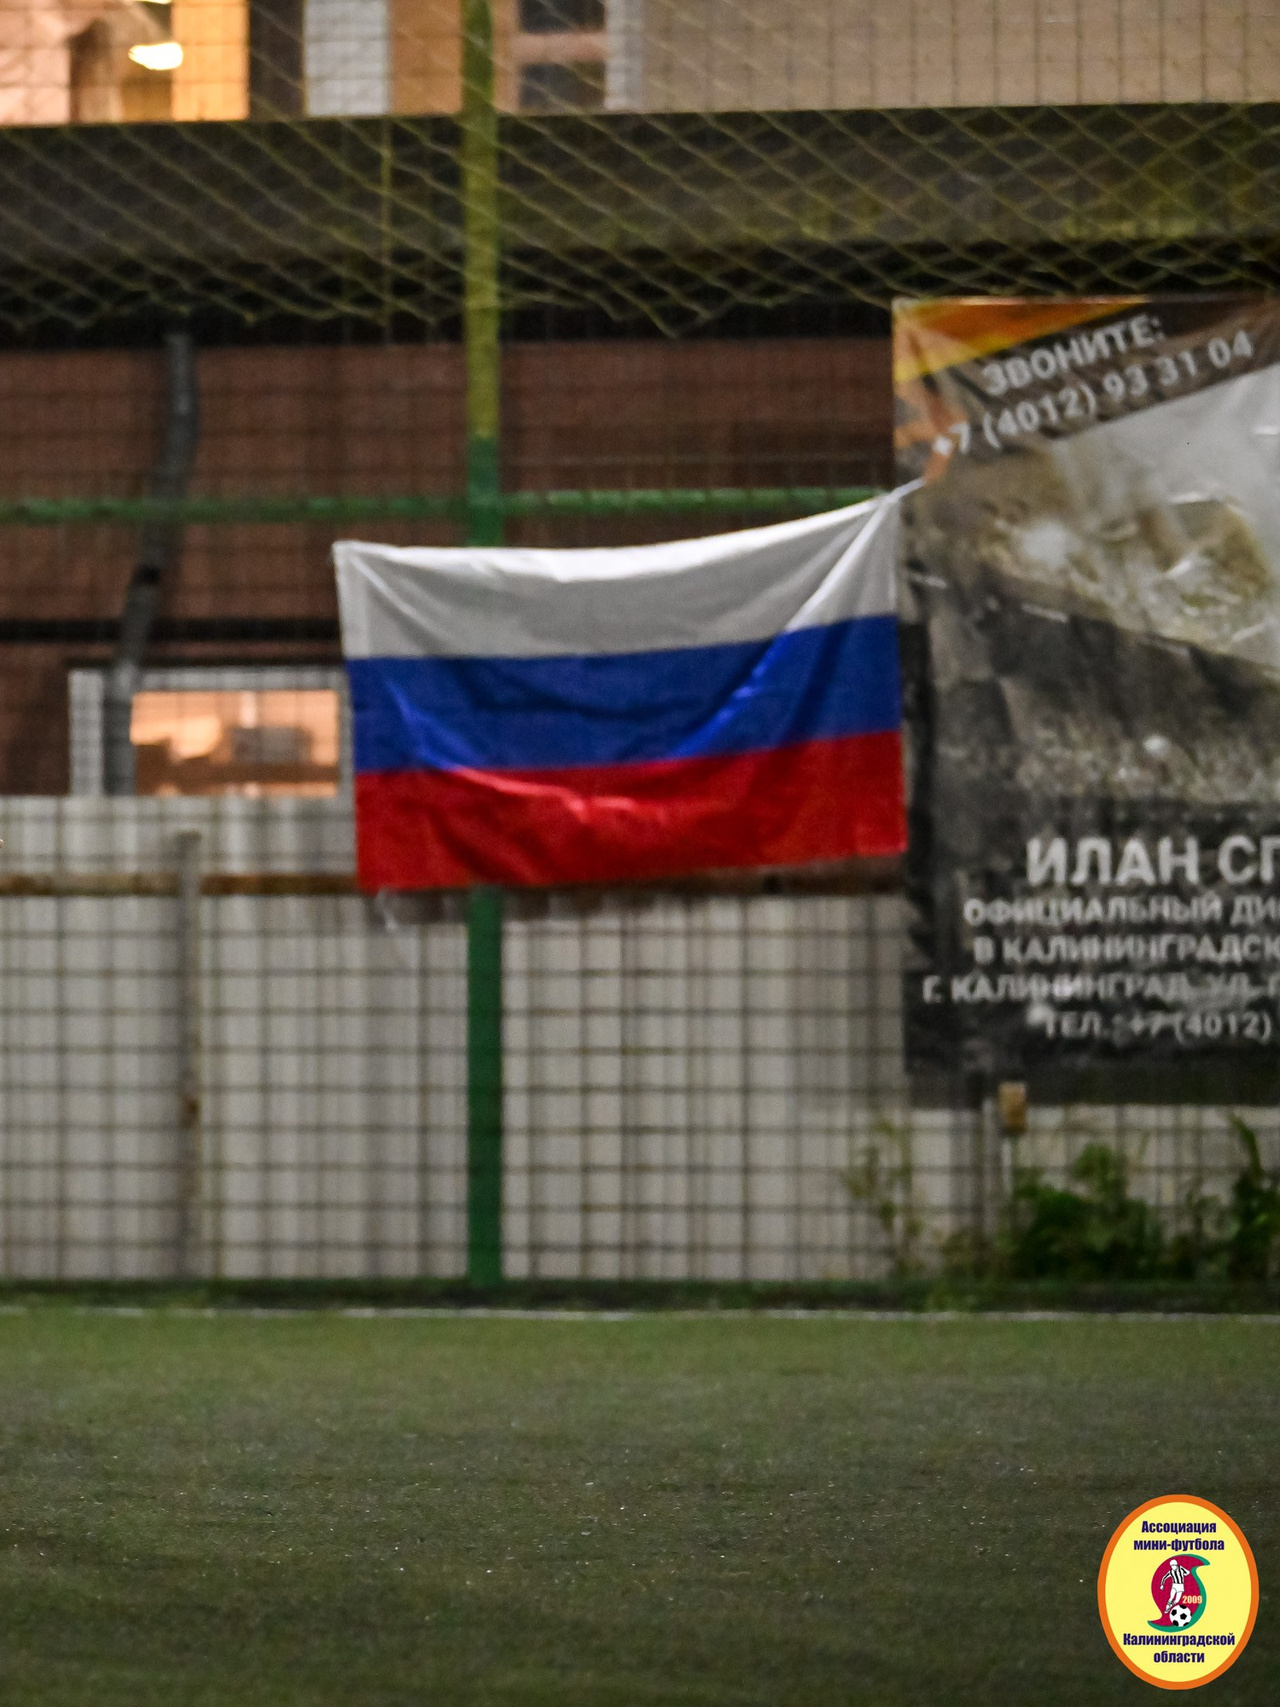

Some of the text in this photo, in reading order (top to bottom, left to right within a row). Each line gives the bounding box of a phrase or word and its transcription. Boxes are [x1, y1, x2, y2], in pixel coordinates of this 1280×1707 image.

[982, 312, 1167, 396] ЗВОНИТЕ:
[982, 381, 1097, 450] (4012)
[1102, 366, 1149, 401] 93
[1156, 350, 1198, 387] 31
[1207, 330, 1254, 368] 04
[1026, 836, 1200, 887] ИЛАН
[963, 890, 1222, 926] ОФИЦИАЛЬНЫЙ
[973, 935, 996, 965] В
